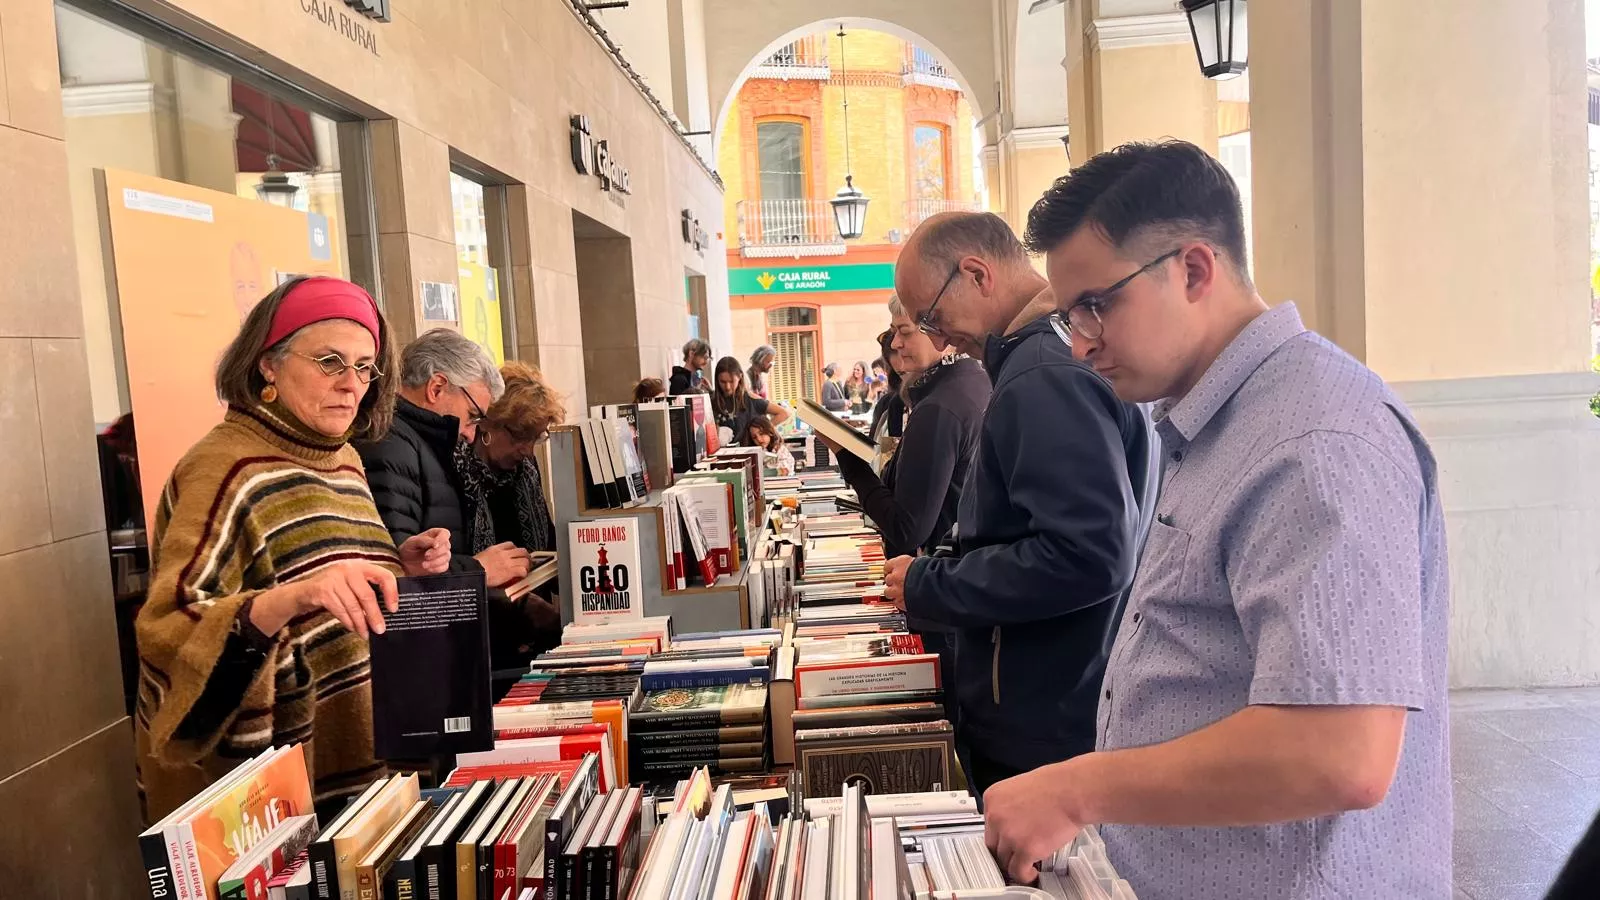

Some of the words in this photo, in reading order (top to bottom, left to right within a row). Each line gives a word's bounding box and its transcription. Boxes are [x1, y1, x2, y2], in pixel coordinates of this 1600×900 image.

[301, 0, 337, 31] CAJA
[340, 13, 381, 57] RURAL
[778, 272, 801, 282] CAJA
[802, 271, 831, 281] RURAL
[784, 282, 794, 290] DE
[796, 281, 826, 290] ARAGÓN
[577, 528, 600, 543] PEDRO
[602, 526, 626, 542] BAÑOS
[580, 564, 629, 593] GEO
[581, 592, 630, 611] HISPANIDAD
[170, 841, 181, 860] VIAJE
[185, 840, 195, 860] VIAJE
[494, 869, 505, 879] 70
[506, 867, 516, 877] 73
[547, 858, 555, 879] ABAD
[148, 866, 169, 899] Una
